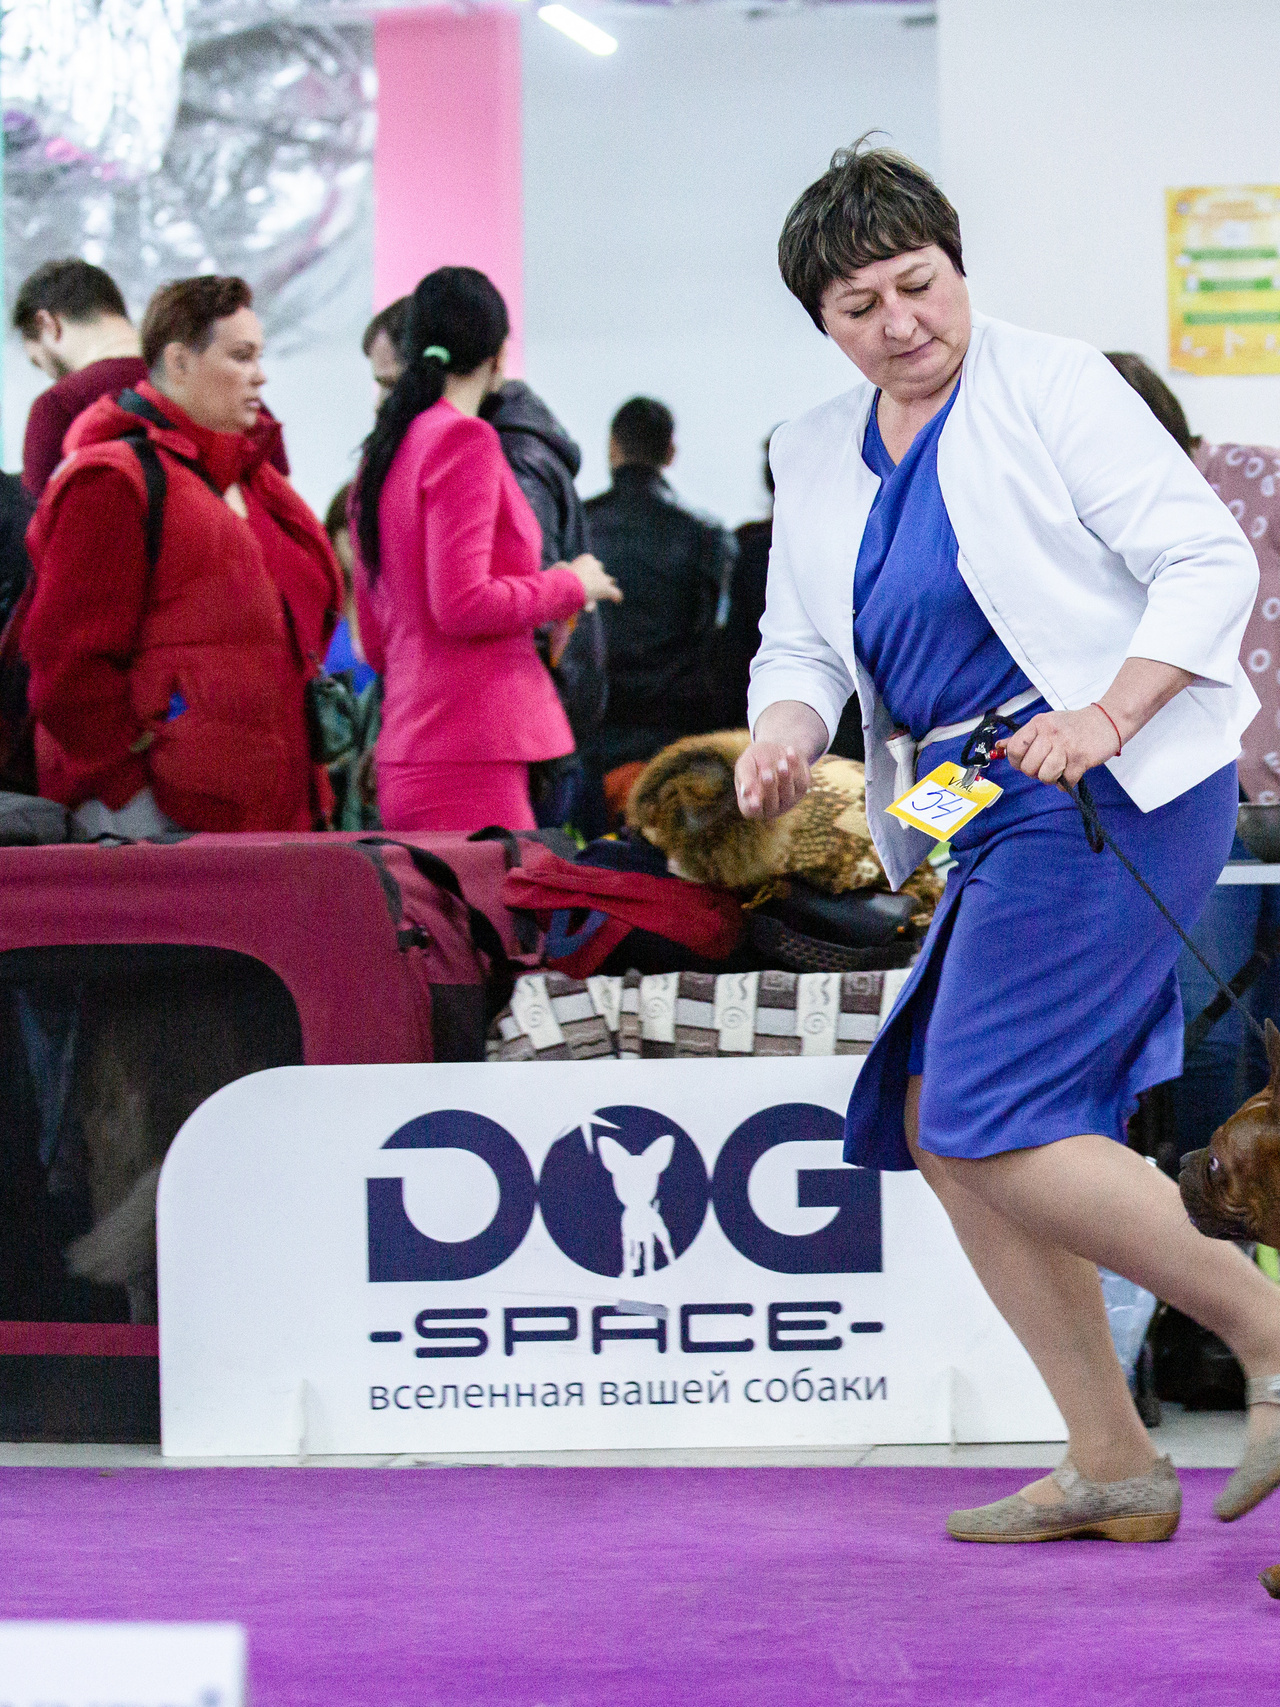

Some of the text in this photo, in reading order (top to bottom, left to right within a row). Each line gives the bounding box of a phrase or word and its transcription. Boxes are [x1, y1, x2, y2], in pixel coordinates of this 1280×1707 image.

[911, 788, 963, 820] 54
[366, 1102, 884, 1283] DOG
[369, 1367, 889, 1410] вселенная вашей собаки
